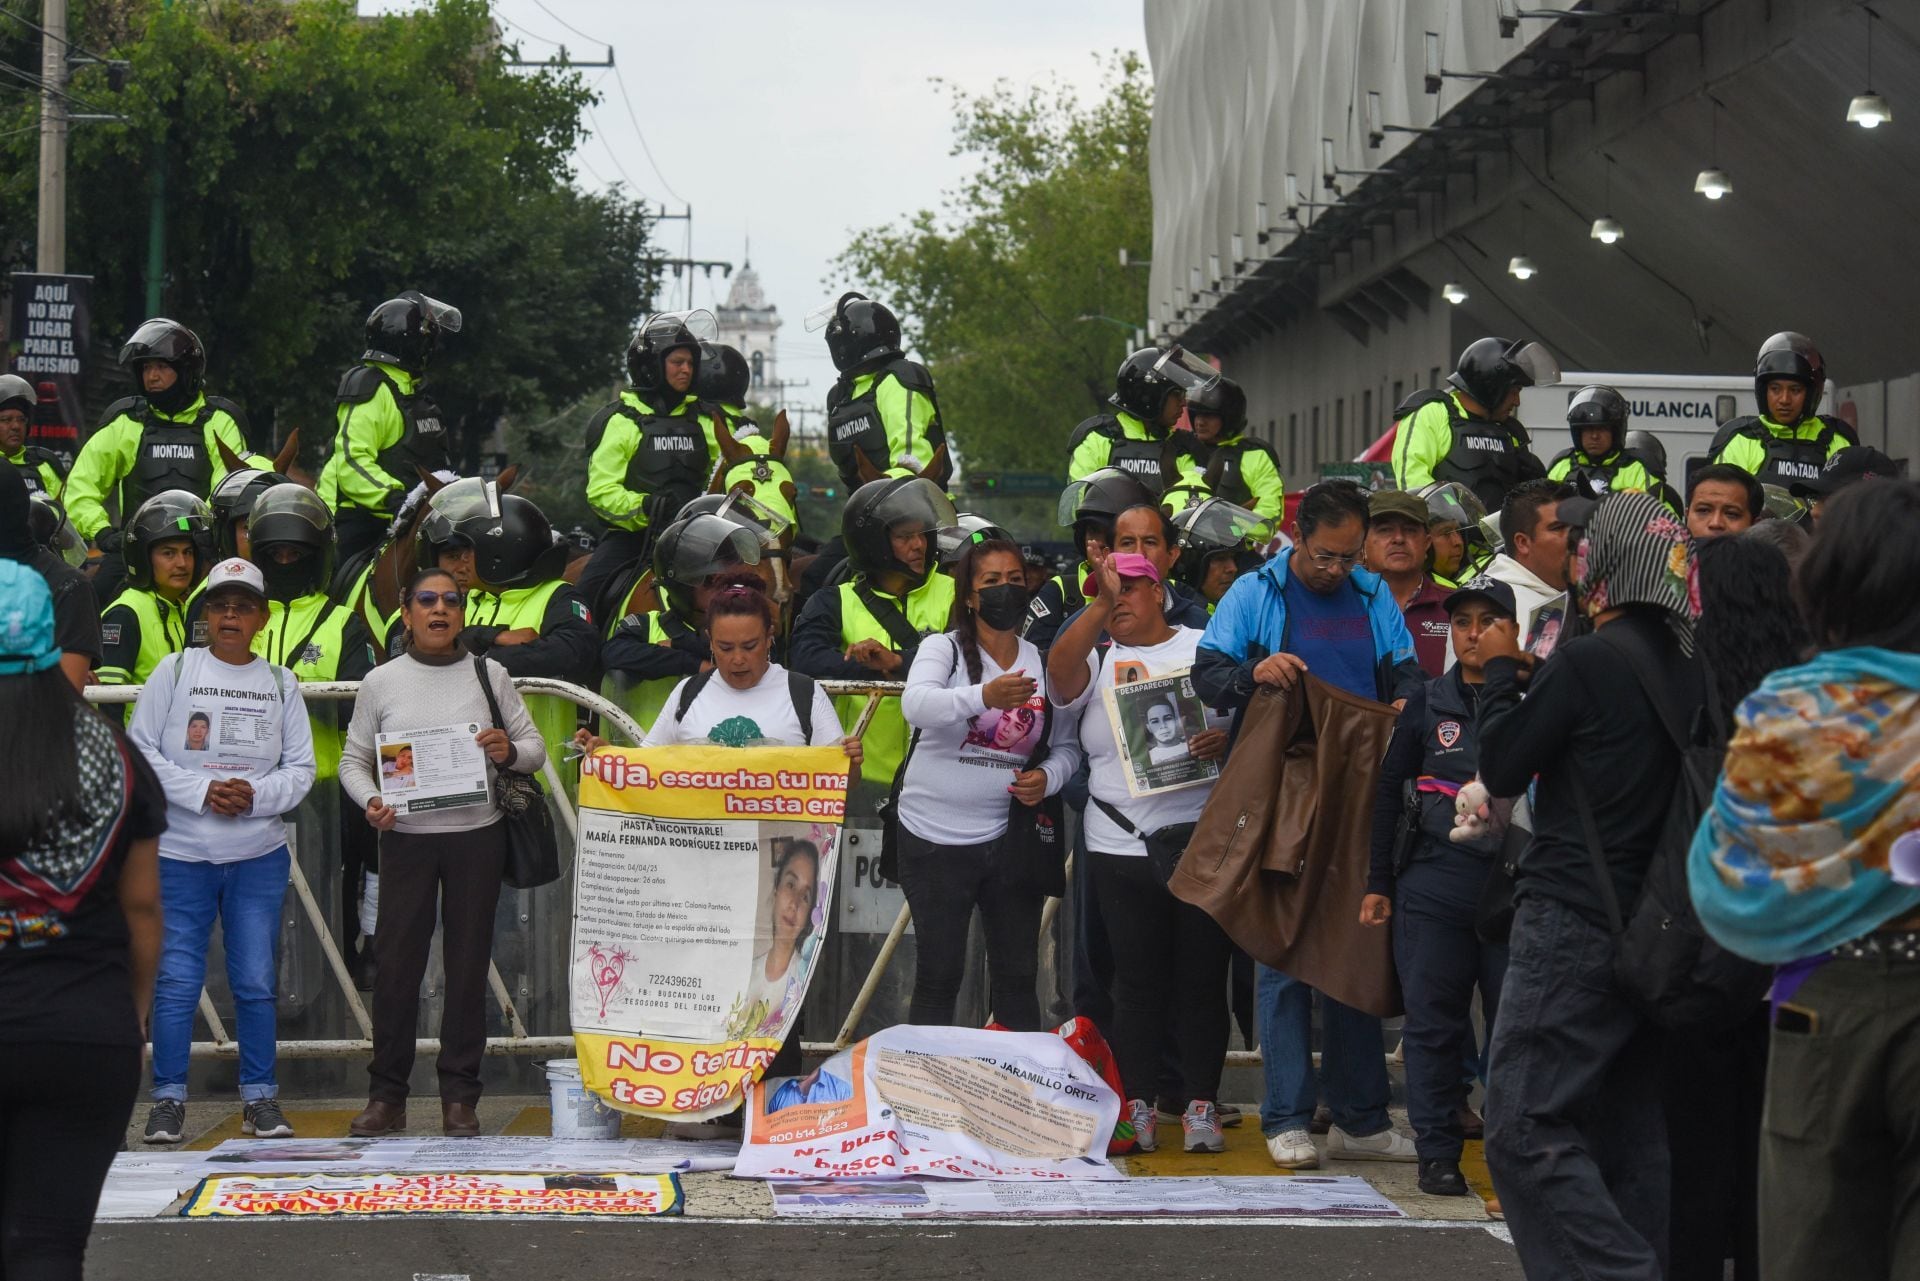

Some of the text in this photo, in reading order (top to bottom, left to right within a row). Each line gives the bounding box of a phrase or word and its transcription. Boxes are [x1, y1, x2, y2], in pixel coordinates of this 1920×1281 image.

[35, 284, 68, 303] AQUÍ
[28, 303, 75, 320] NO HAY
[29, 321, 71, 338] LUGAR
[24, 338, 75, 356] PARA EL
[17, 356, 80, 375] RACISMO
[837, 416, 871, 441] MONTADA
[152, 445, 195, 459] MONTADA
[654, 436, 694, 451] MONTADA
[1466, 436, 1505, 453] MONTADA
[1778, 461, 1819, 480] MONTADA
[189, 686, 277, 702] ¡HASTA ENCONTRARTE!
[1120, 678, 1174, 696] DESAPARECIDO
[660, 768, 774, 790] escucha
[777, 770, 809, 789] tu
[725, 793, 803, 815] hasta
[620, 819, 723, 836] ¡HASTA ENCONTRARLE!
[586, 830, 759, 852] MARÍA FERNANDA RODRÍGUEZ ZEPEDA
[648, 974, 702, 989] 7224396261
[658, 989, 698, 1001] BUSCANDO
[674, 1001, 689, 1010] DEL
[694, 1003, 721, 1013] EDOMEX
[607, 1041, 684, 1075] No
[1000, 1061, 1062, 1090] JARAMILLO
[1064, 1085, 1099, 1103] ORTIZ.
[610, 1078, 666, 1108] te
[769, 1132, 793, 1144] 800
[795, 1128, 816, 1139] 614
